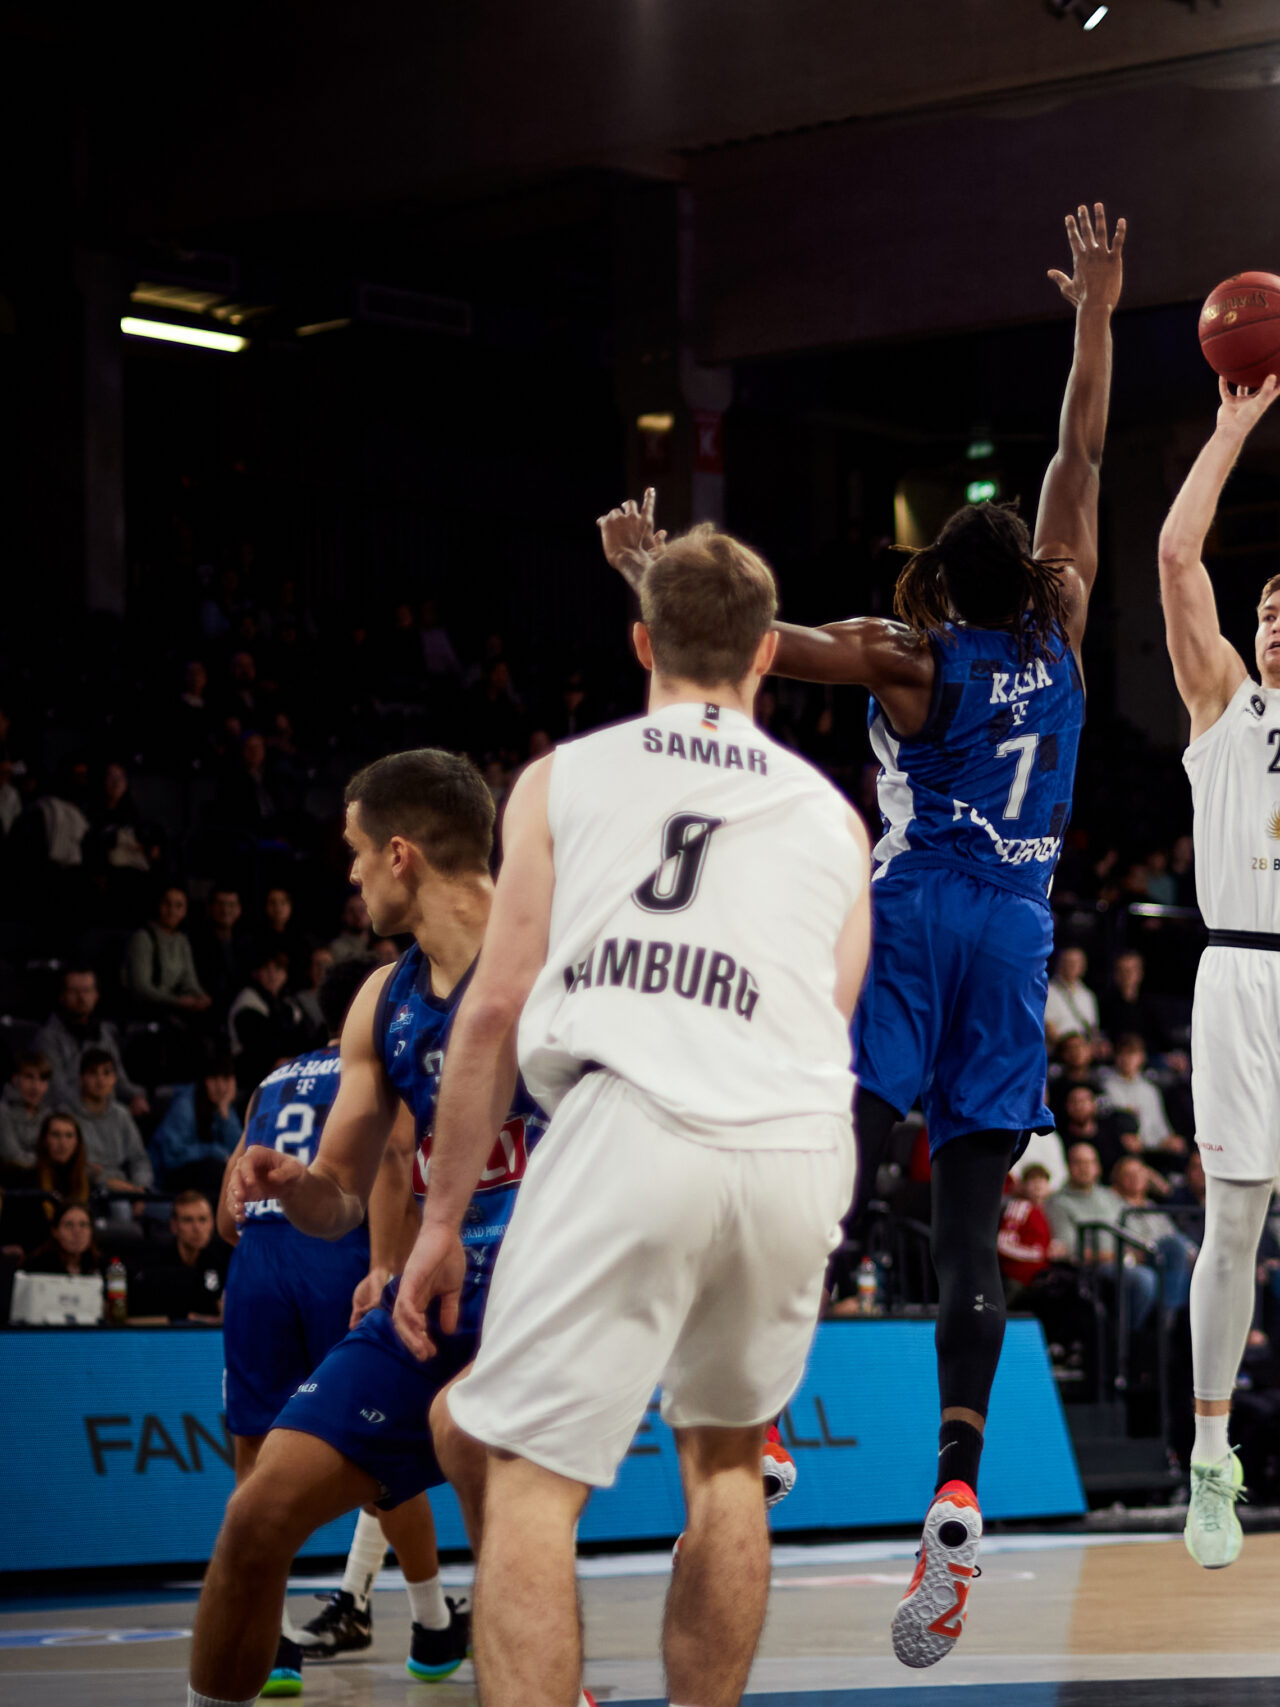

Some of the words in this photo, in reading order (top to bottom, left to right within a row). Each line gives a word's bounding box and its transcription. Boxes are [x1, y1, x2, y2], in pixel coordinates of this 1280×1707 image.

[642, 727, 768, 776] SAMAR
[993, 733, 1039, 820] 7
[1251, 857, 1267, 870] 28
[275, 1103, 315, 1167] 2
